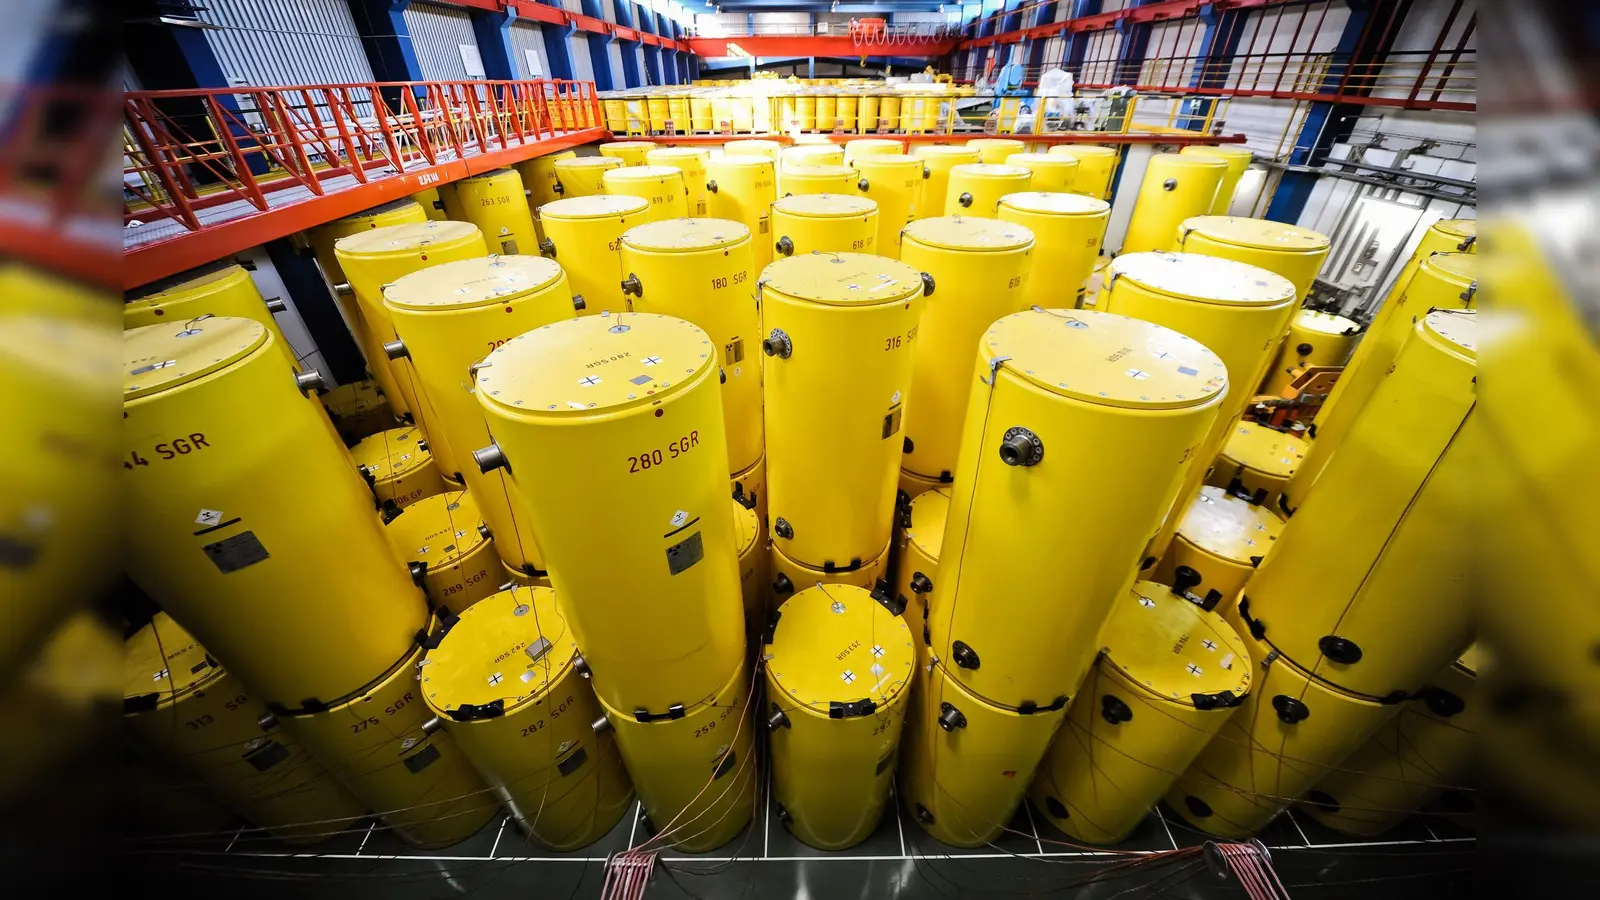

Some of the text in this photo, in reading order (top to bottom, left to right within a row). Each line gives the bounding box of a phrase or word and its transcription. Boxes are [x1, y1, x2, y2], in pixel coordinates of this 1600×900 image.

[481, 196, 510, 206] 263 SGR
[853, 240, 864, 249] 618
[712, 271, 747, 290] 180 SGR
[885, 336, 901, 351] 316
[585, 352, 631, 369] 280 SGR
[155, 432, 210, 460] SGR
[628, 430, 700, 474] 280 SGR
[411, 488, 423, 500] GP
[443, 570, 487, 597] 289 SGR
[494, 642, 525, 664] 282 SGR
[836, 640, 860, 661] 253 SGR
[1172, 643, 1183, 654] SGR
[186, 693, 251, 730] 313 SG
[350, 692, 414, 734] 275 SGR
[521, 696, 574, 738] 282 SGR
[694, 697, 739, 739] 259 SGR
